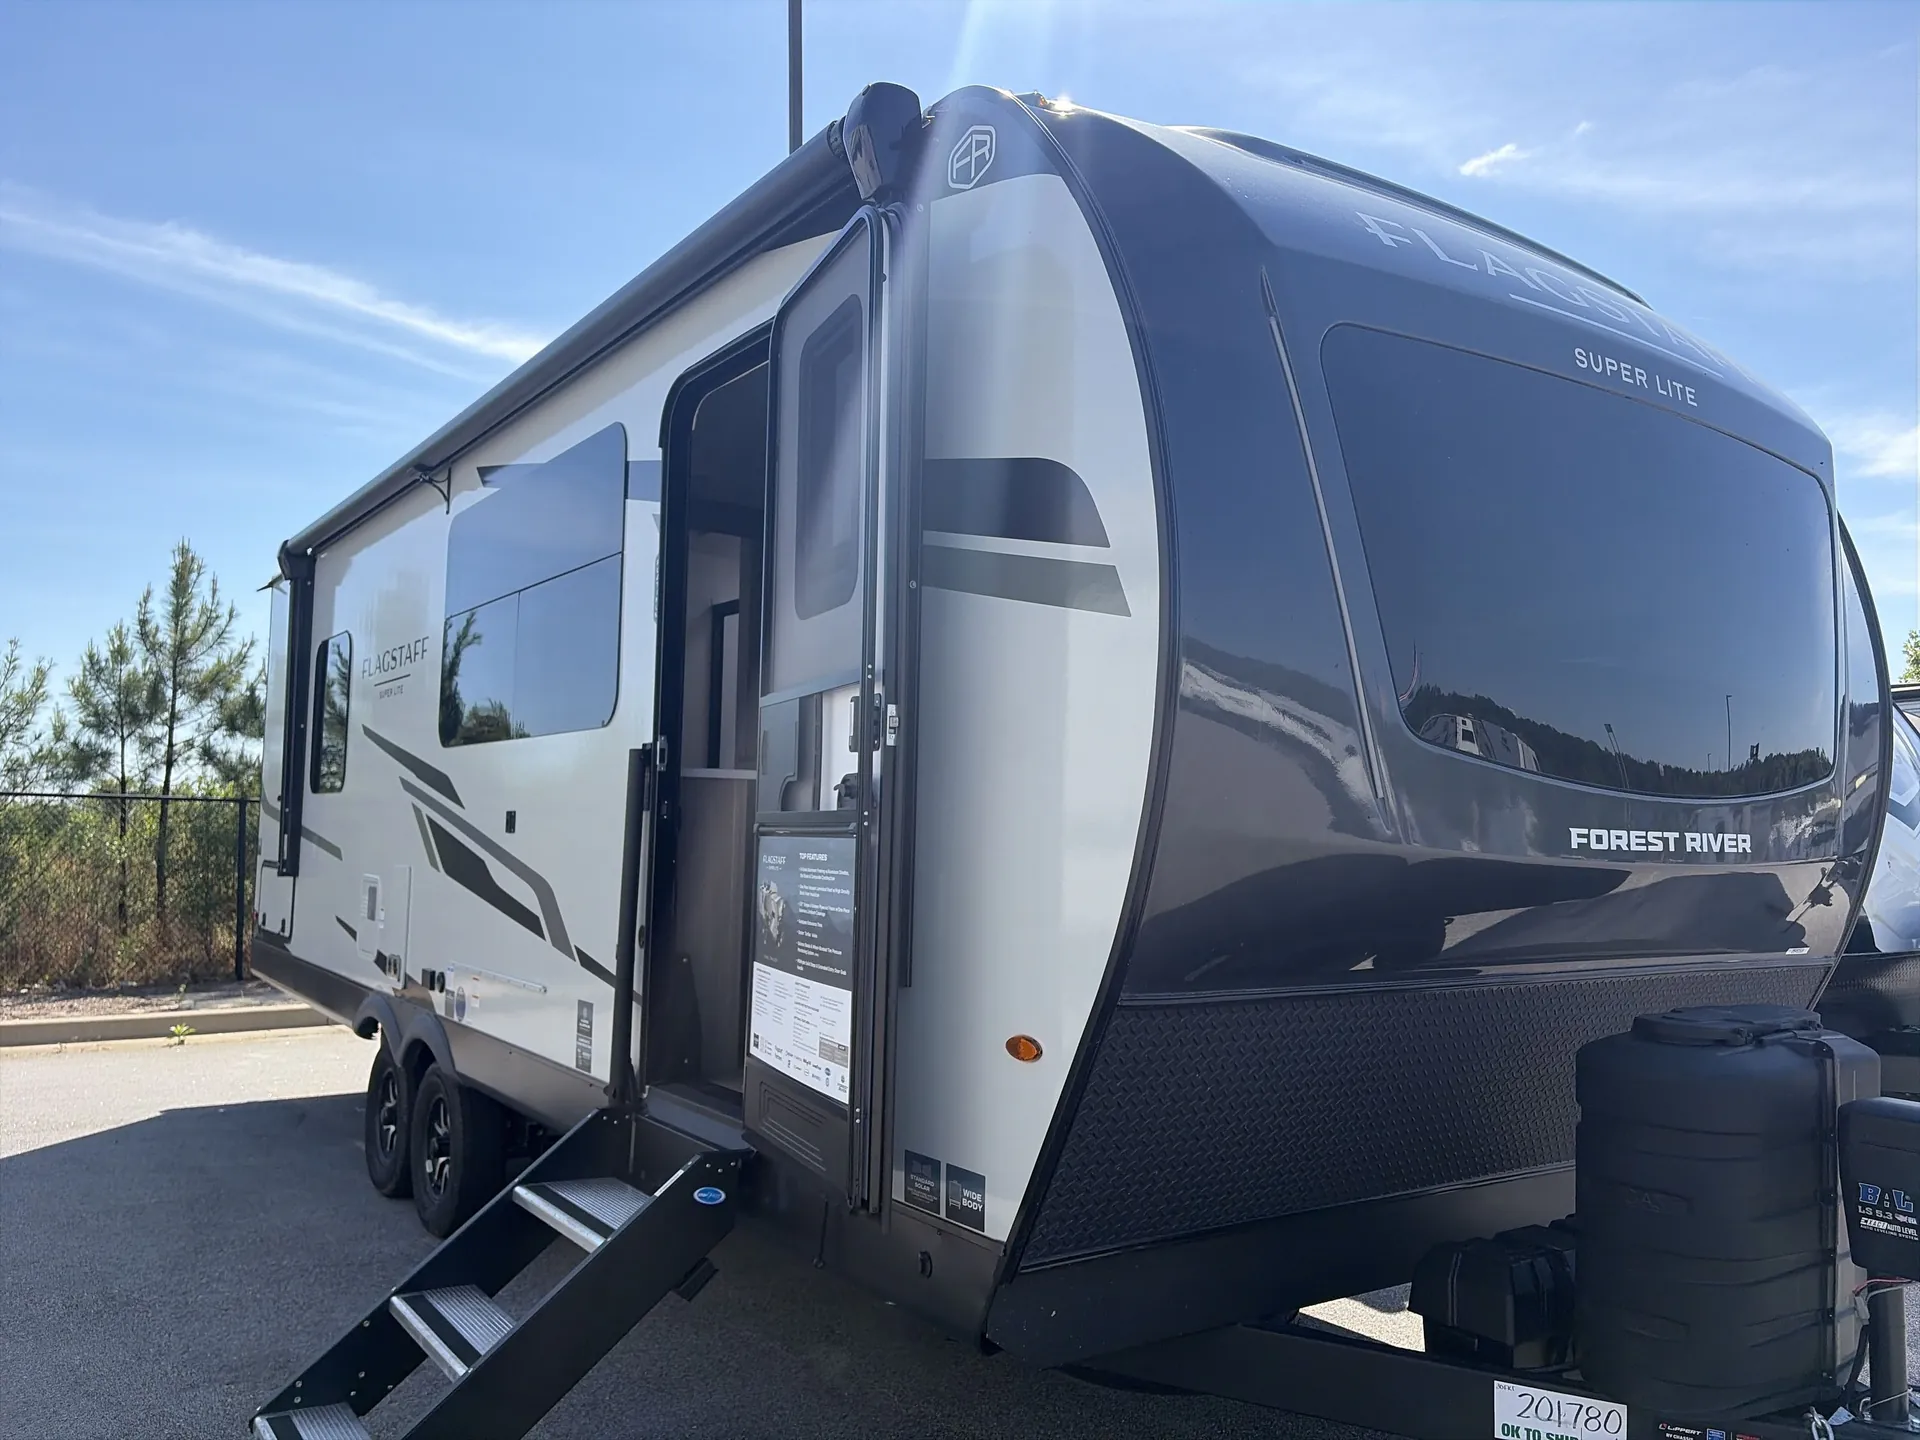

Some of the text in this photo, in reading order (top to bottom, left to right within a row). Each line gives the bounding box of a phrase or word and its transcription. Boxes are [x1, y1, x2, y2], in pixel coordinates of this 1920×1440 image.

[1355, 211, 1732, 370] FLAGSTAF
[1574, 347, 1698, 407] SUPER LITE
[361, 635, 429, 680] FLAGSTAFF
[1569, 828, 1752, 853] FOREST RIVER
[762, 854, 787, 865] FLAGSTAFF
[799, 852, 828, 861] TOP FEATURES
[910, 1174, 935, 1187] STANDARD
[914, 1182, 930, 1192] SOLAR
[962, 1188, 983, 1203] WIDE
[962, 1198, 983, 1212] BODY
[1858, 1205, 1893, 1220] LS 5.3
[1887, 1223, 1901, 1233] AUTO
[1901, 1226, 1919, 1237] LEVEL
[1516, 1393, 1622, 1434] 201780
[1501, 1423, 1521, 1439] OK
[1524, 1428, 1541, 1440] TO
[1667, 1425, 1703, 1436] LIPPERT
